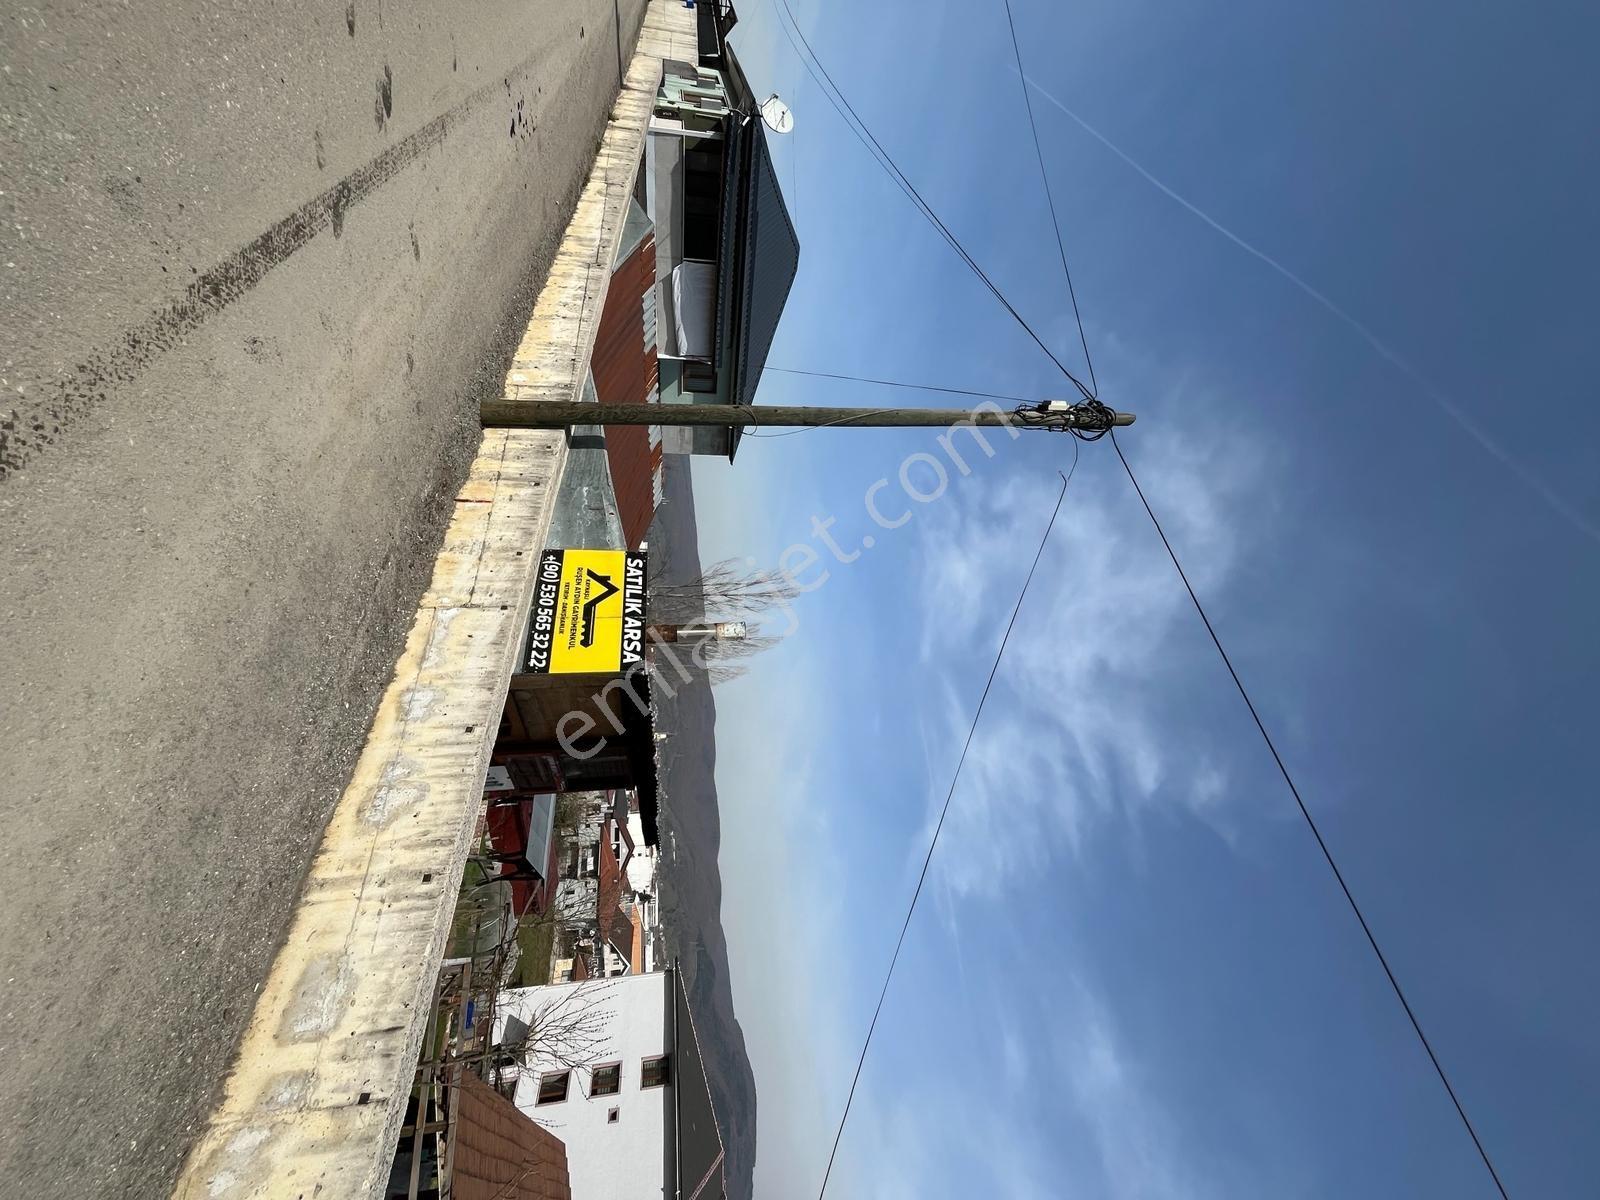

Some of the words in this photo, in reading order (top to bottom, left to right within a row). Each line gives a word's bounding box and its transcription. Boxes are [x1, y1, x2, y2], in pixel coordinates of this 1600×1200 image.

[540, 555, 561, 582] +(90)
[574, 567, 583, 586] RUŞEN
[539, 584, 556, 606] 530
[625, 558, 643, 614] SATILIK
[535, 608, 552, 631] 565
[568, 606, 580, 650] GAYRİMENKUL
[533, 632, 548, 648] 32
[623, 617, 641, 663] ARSA
[530, 650, 546, 667] 22
